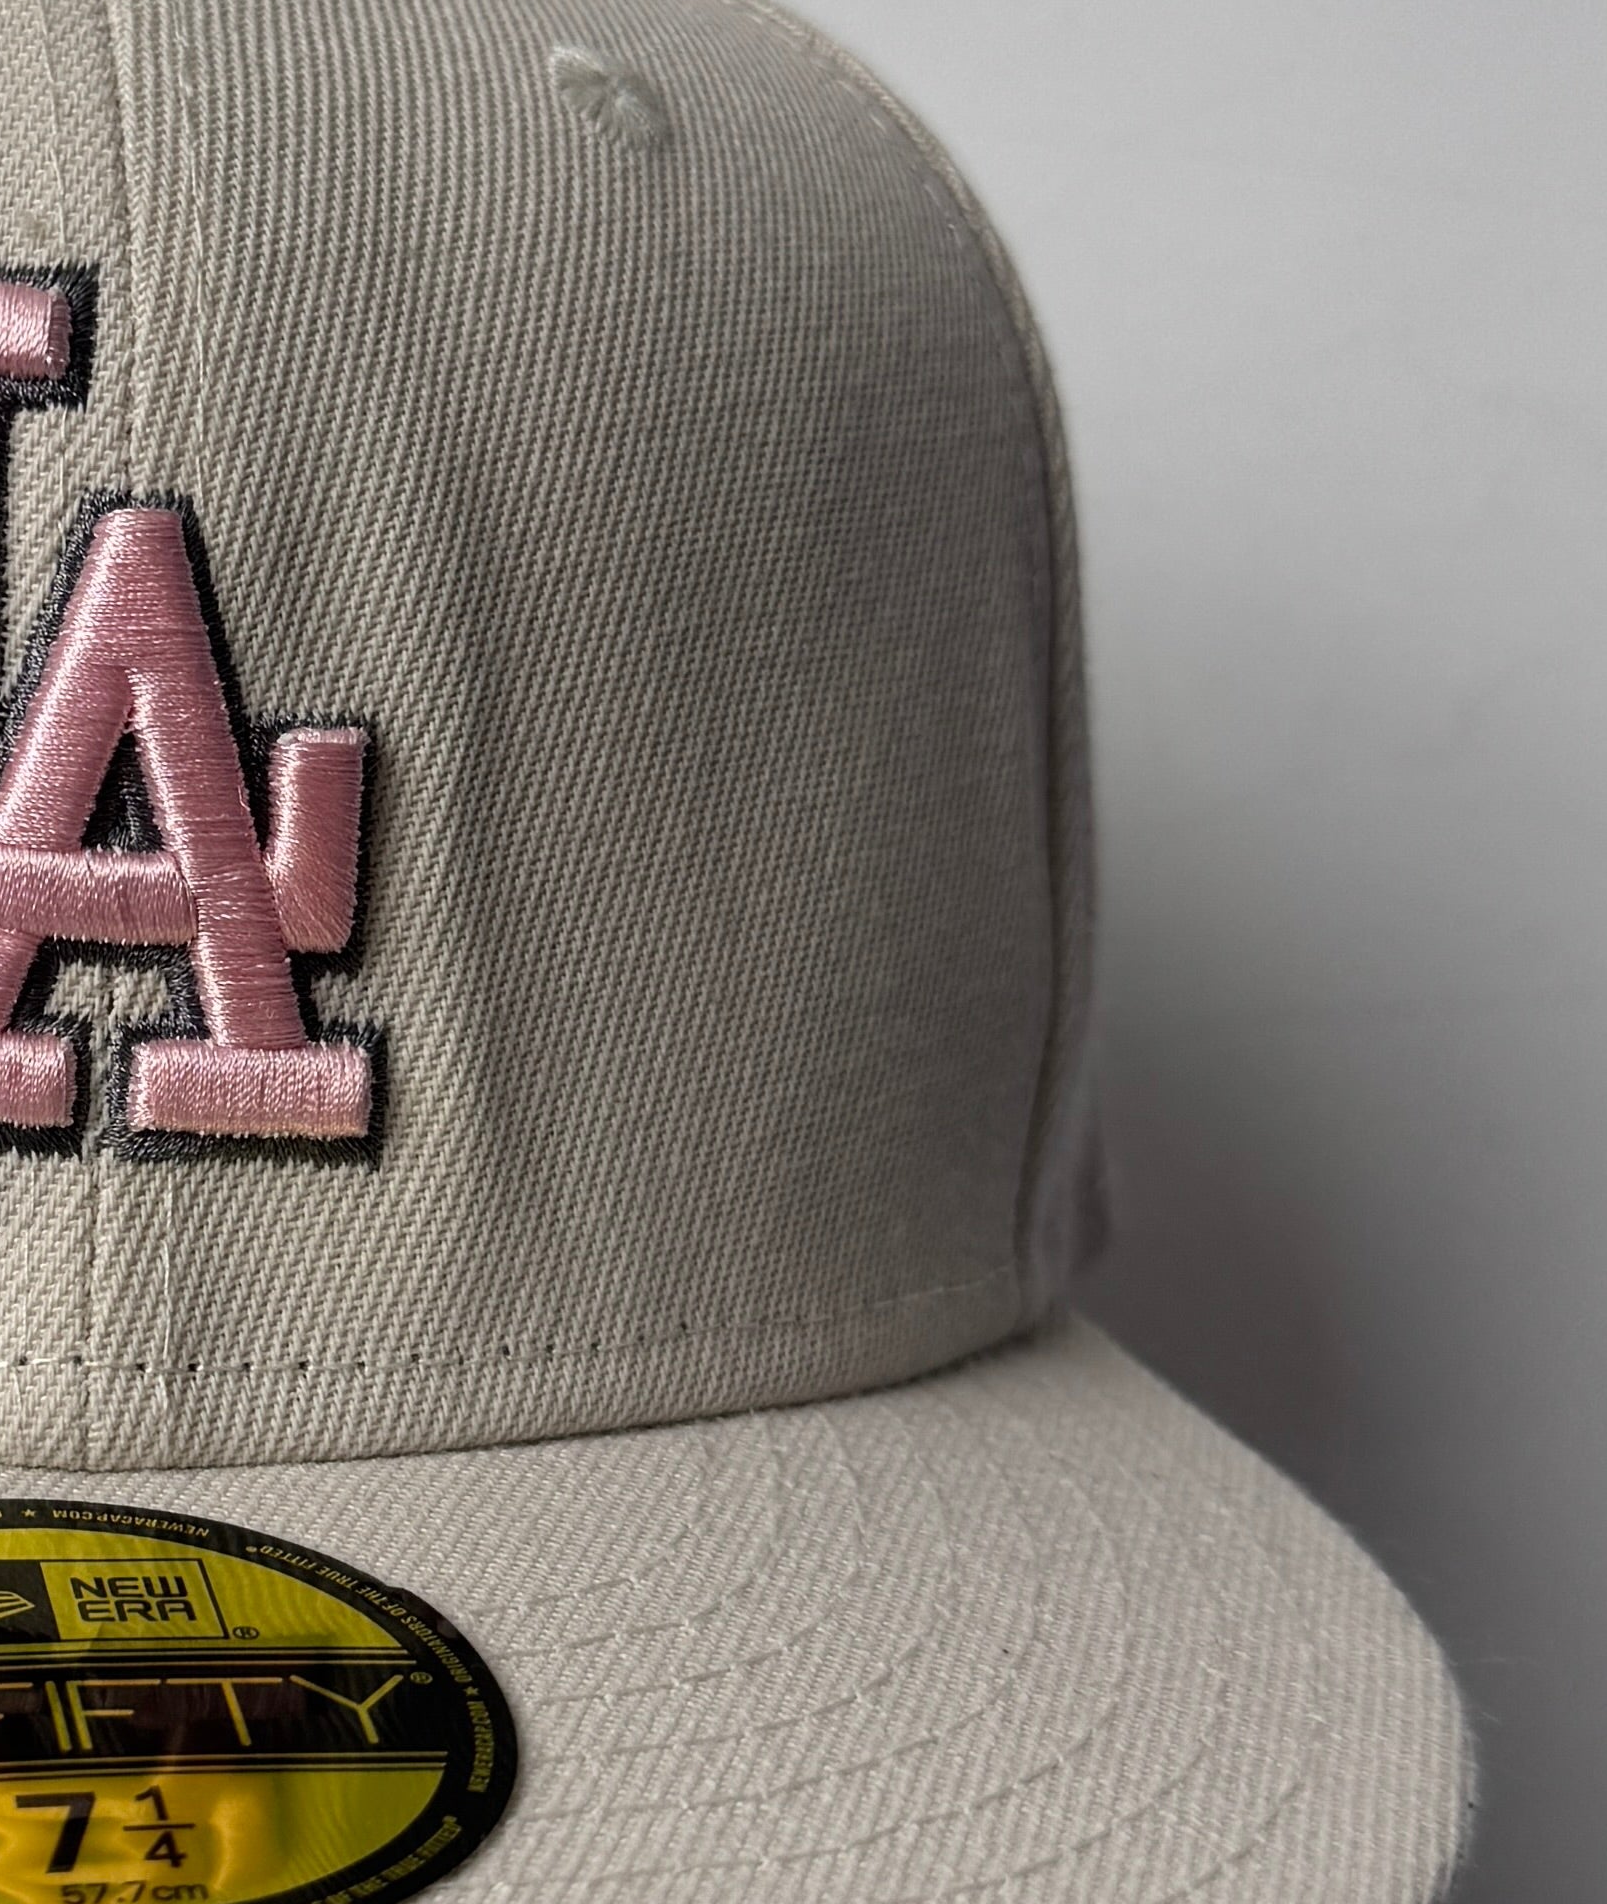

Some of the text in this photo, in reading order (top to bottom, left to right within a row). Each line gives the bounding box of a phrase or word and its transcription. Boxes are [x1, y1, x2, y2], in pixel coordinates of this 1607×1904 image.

[69, 1575, 188, 1600] NEW
[315, 1565, 360, 1592] TRUE
[76, 1599, 198, 1624] ERA
[15, 1791, 96, 1874] 7
